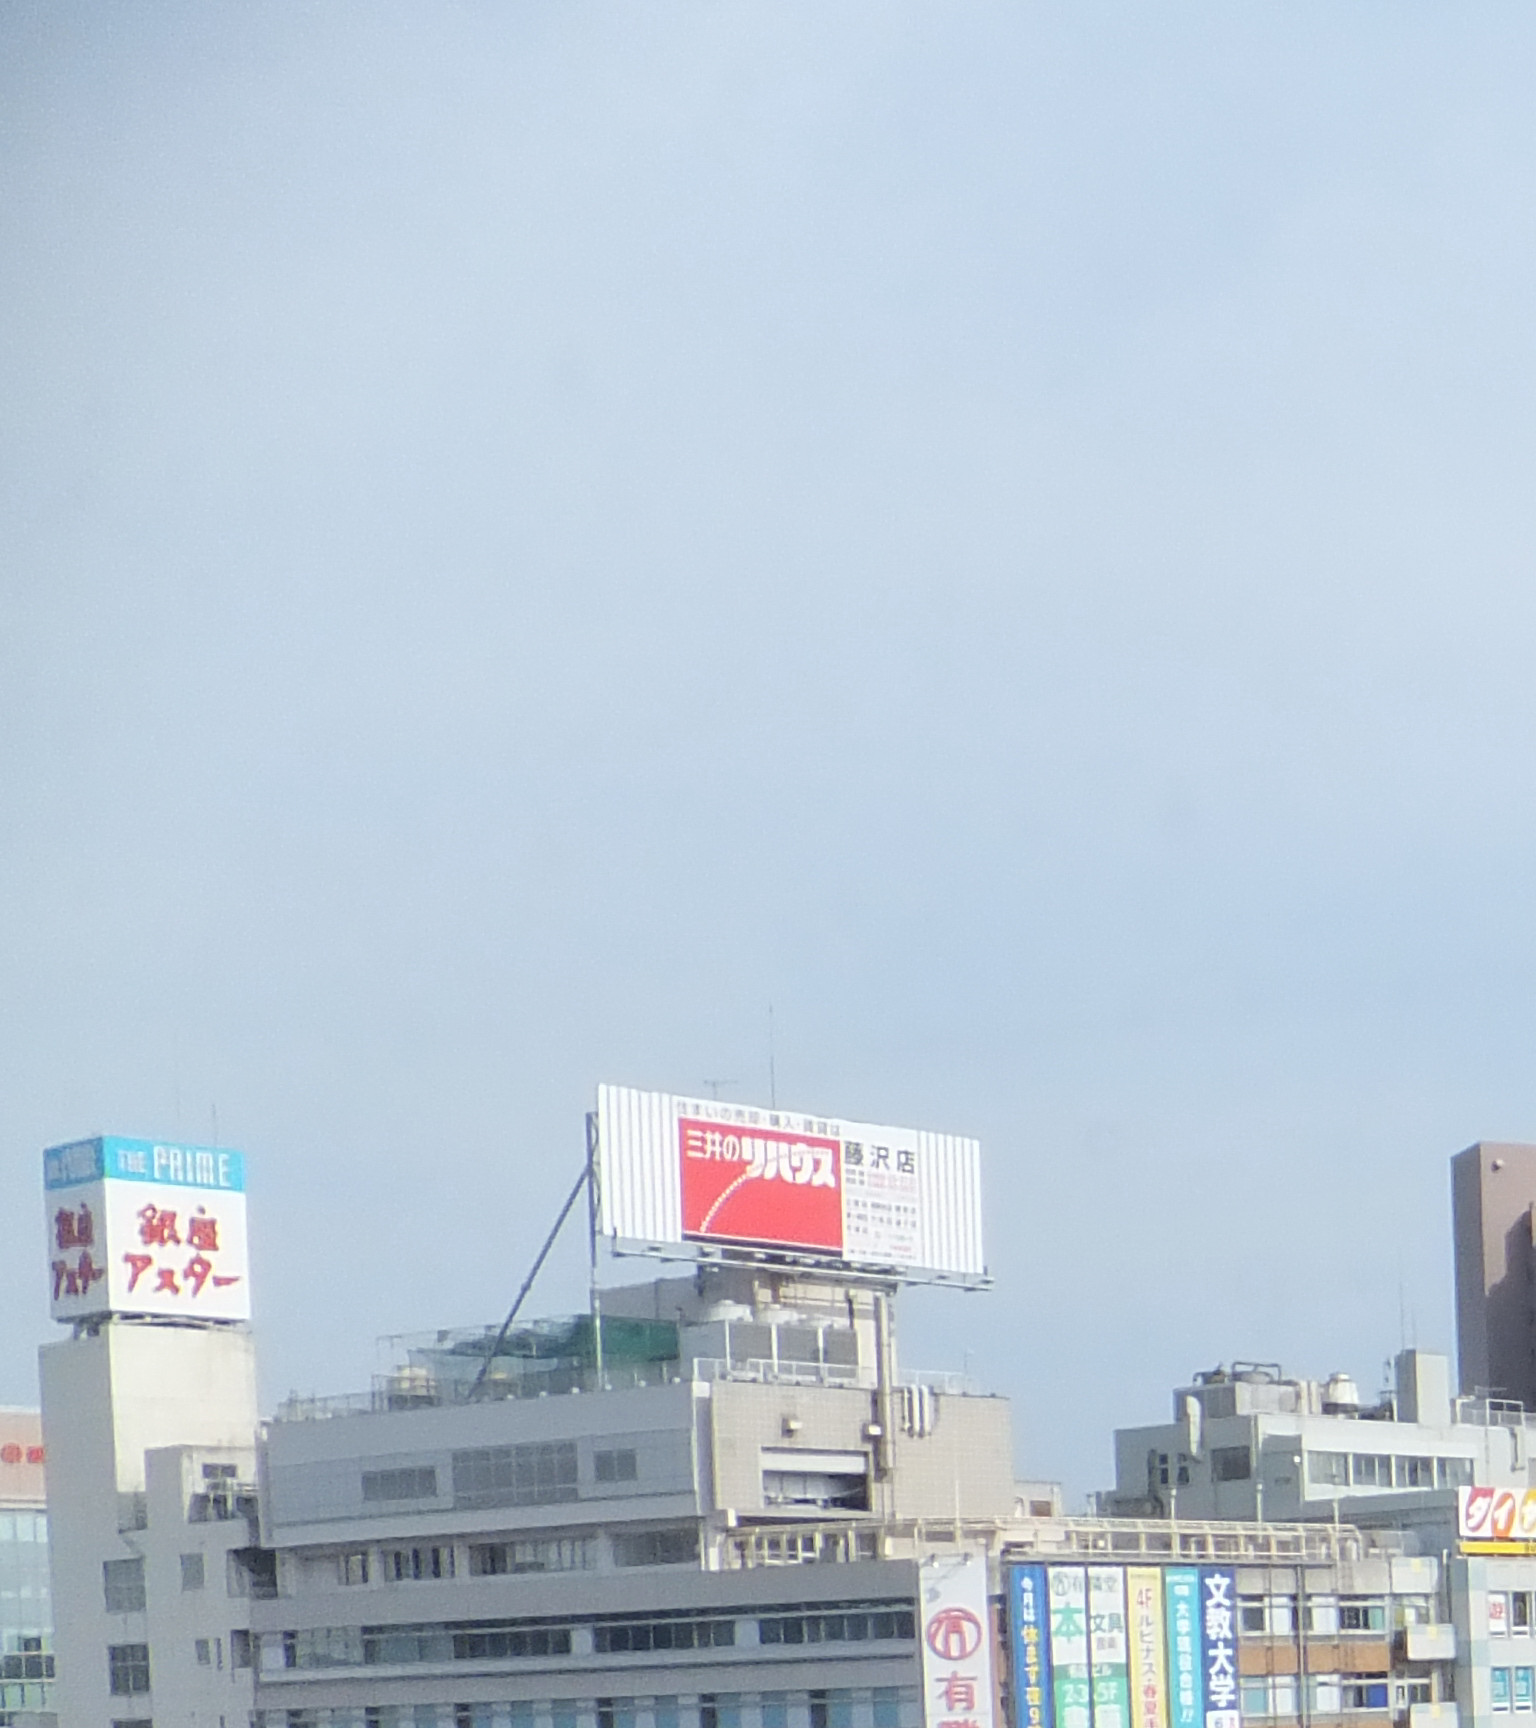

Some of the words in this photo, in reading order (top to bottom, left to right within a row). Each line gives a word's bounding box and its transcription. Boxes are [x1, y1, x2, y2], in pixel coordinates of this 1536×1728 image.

[153, 1145, 232, 1188] PRIME
[686, 1128, 837, 1189] 三井のリハウス
[844, 1140, 915, 1175] 藤沢店
[123, 1252, 241, 1298] アスター
[1136, 1587, 1153, 1608] 4F
[1204, 1573, 1236, 1708] 文教大学
